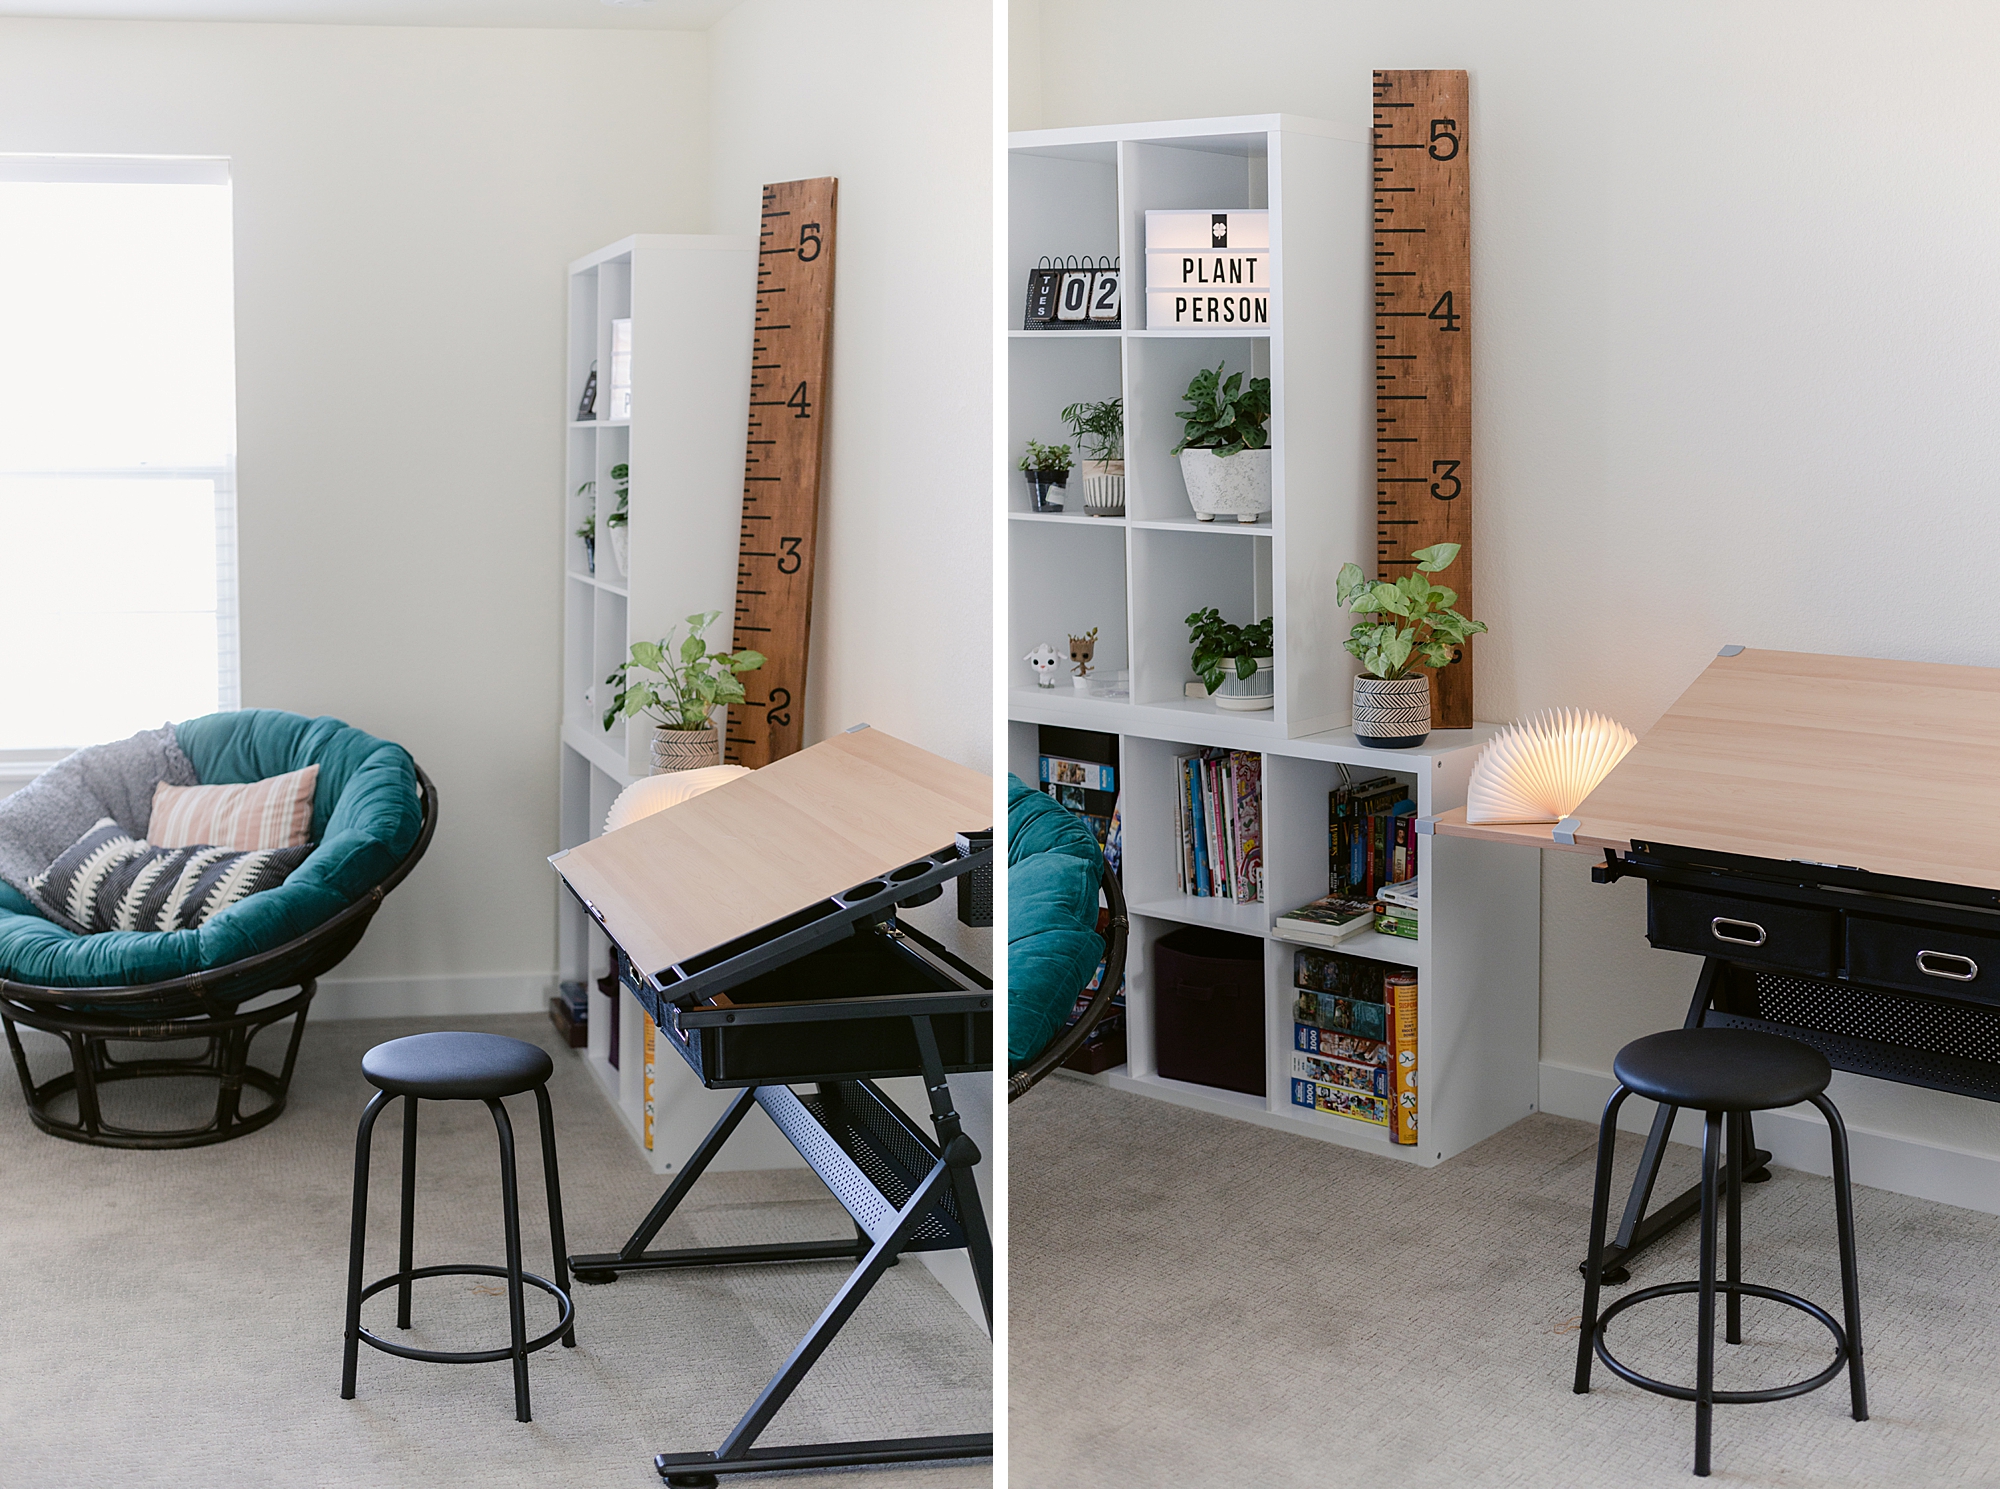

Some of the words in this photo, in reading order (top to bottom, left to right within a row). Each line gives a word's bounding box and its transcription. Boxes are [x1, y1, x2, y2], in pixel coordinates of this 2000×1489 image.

[1428, 118, 1458, 161] 5
[798, 223, 821, 262] 5
[1182, 257, 1258, 284] PLANT
[1037, 276, 1051, 316] TUES
[1175, 296, 1267, 323] PERSON
[1428, 290, 1460, 332] 4
[786, 380, 812, 419] 4
[1430, 459, 1462, 501] 3
[777, 536, 803, 575] 3
[766, 686, 791, 727] 2
[1330, 823, 1338, 857] WARRIORS
[1306, 1084, 1314, 1105] 1000
